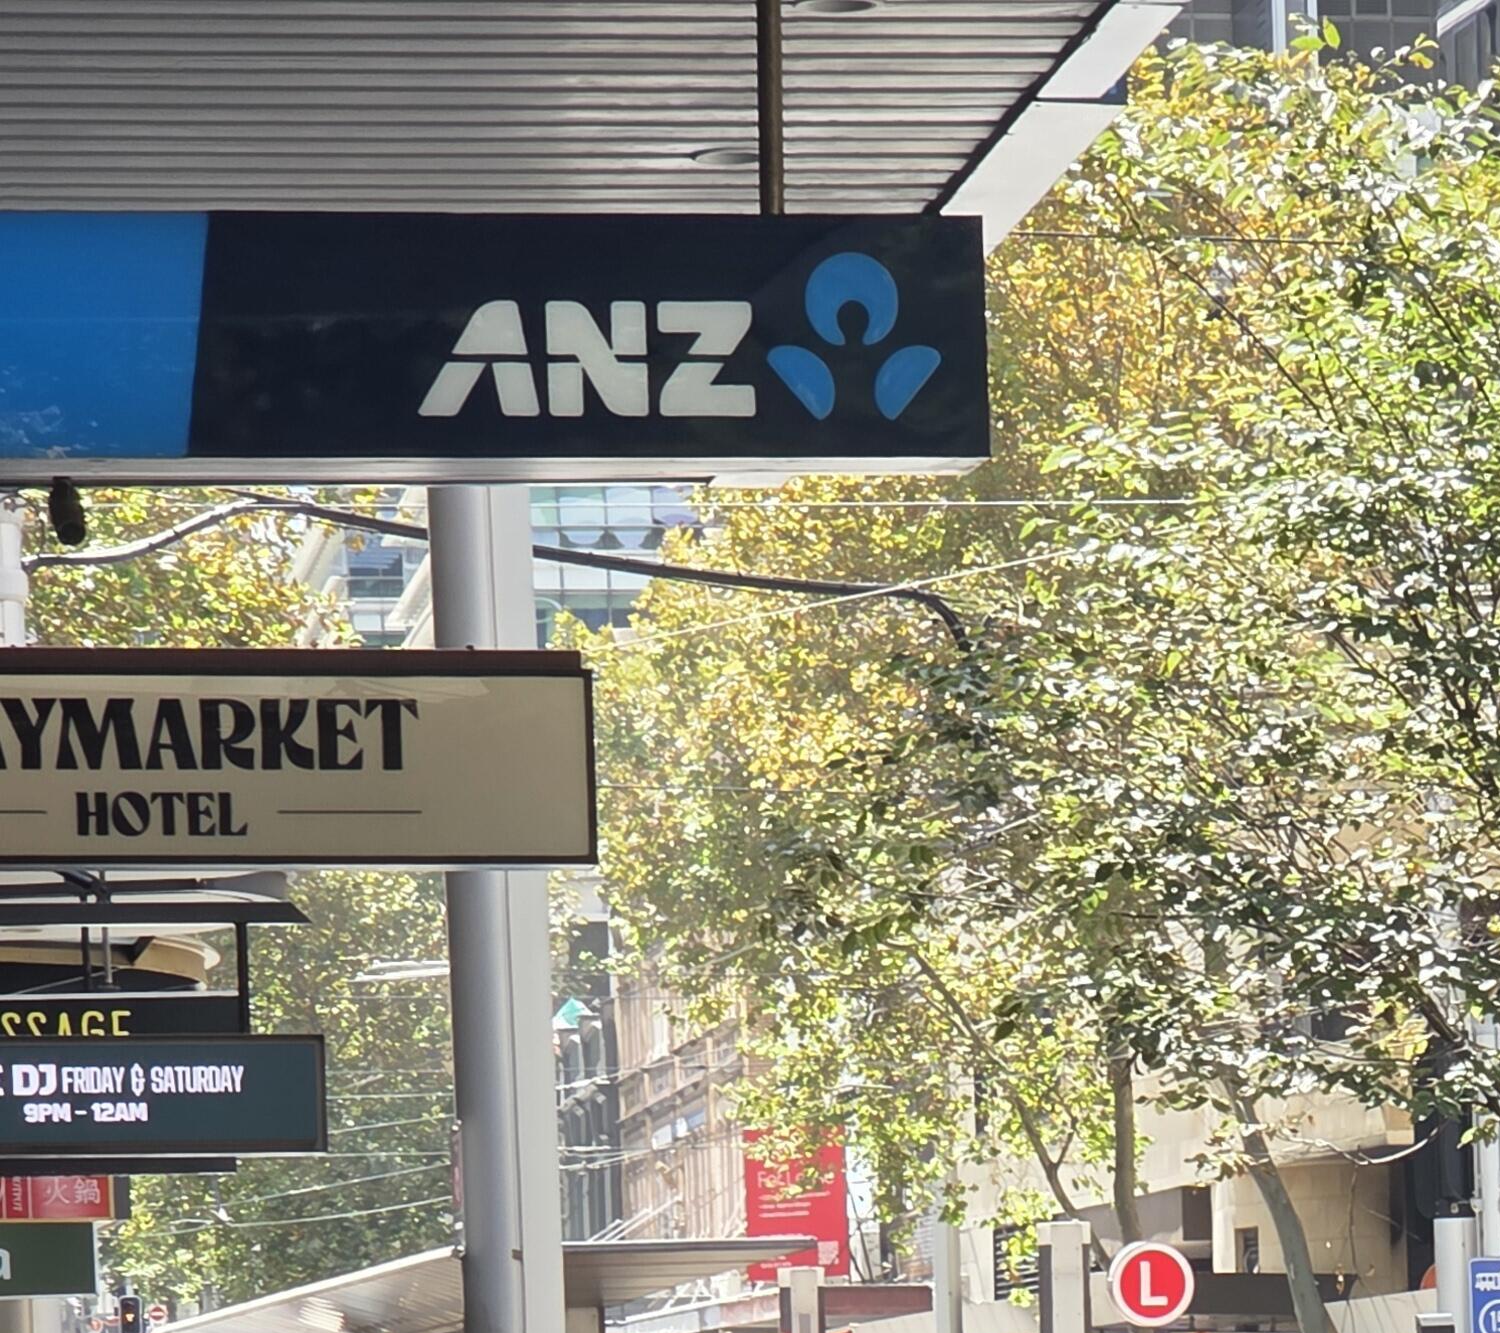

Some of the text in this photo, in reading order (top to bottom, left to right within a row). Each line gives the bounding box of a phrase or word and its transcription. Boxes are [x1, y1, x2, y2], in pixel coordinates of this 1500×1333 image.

[417, 299, 756, 417] ANZ
[0, 698, 419, 770] YMARKET
[75, 792, 248, 836] HOTEL
[12, 1064, 57, 1097] DJ
[62, 1066, 126, 1094] FRIDAY
[130, 1063, 146, 1097] &
[151, 1065, 244, 1093] SATURDAY
[24, 1103, 72, 1123] 9PM
[91, 1102, 148, 1122] 12AM
[1139, 1260, 1168, 1306] L
